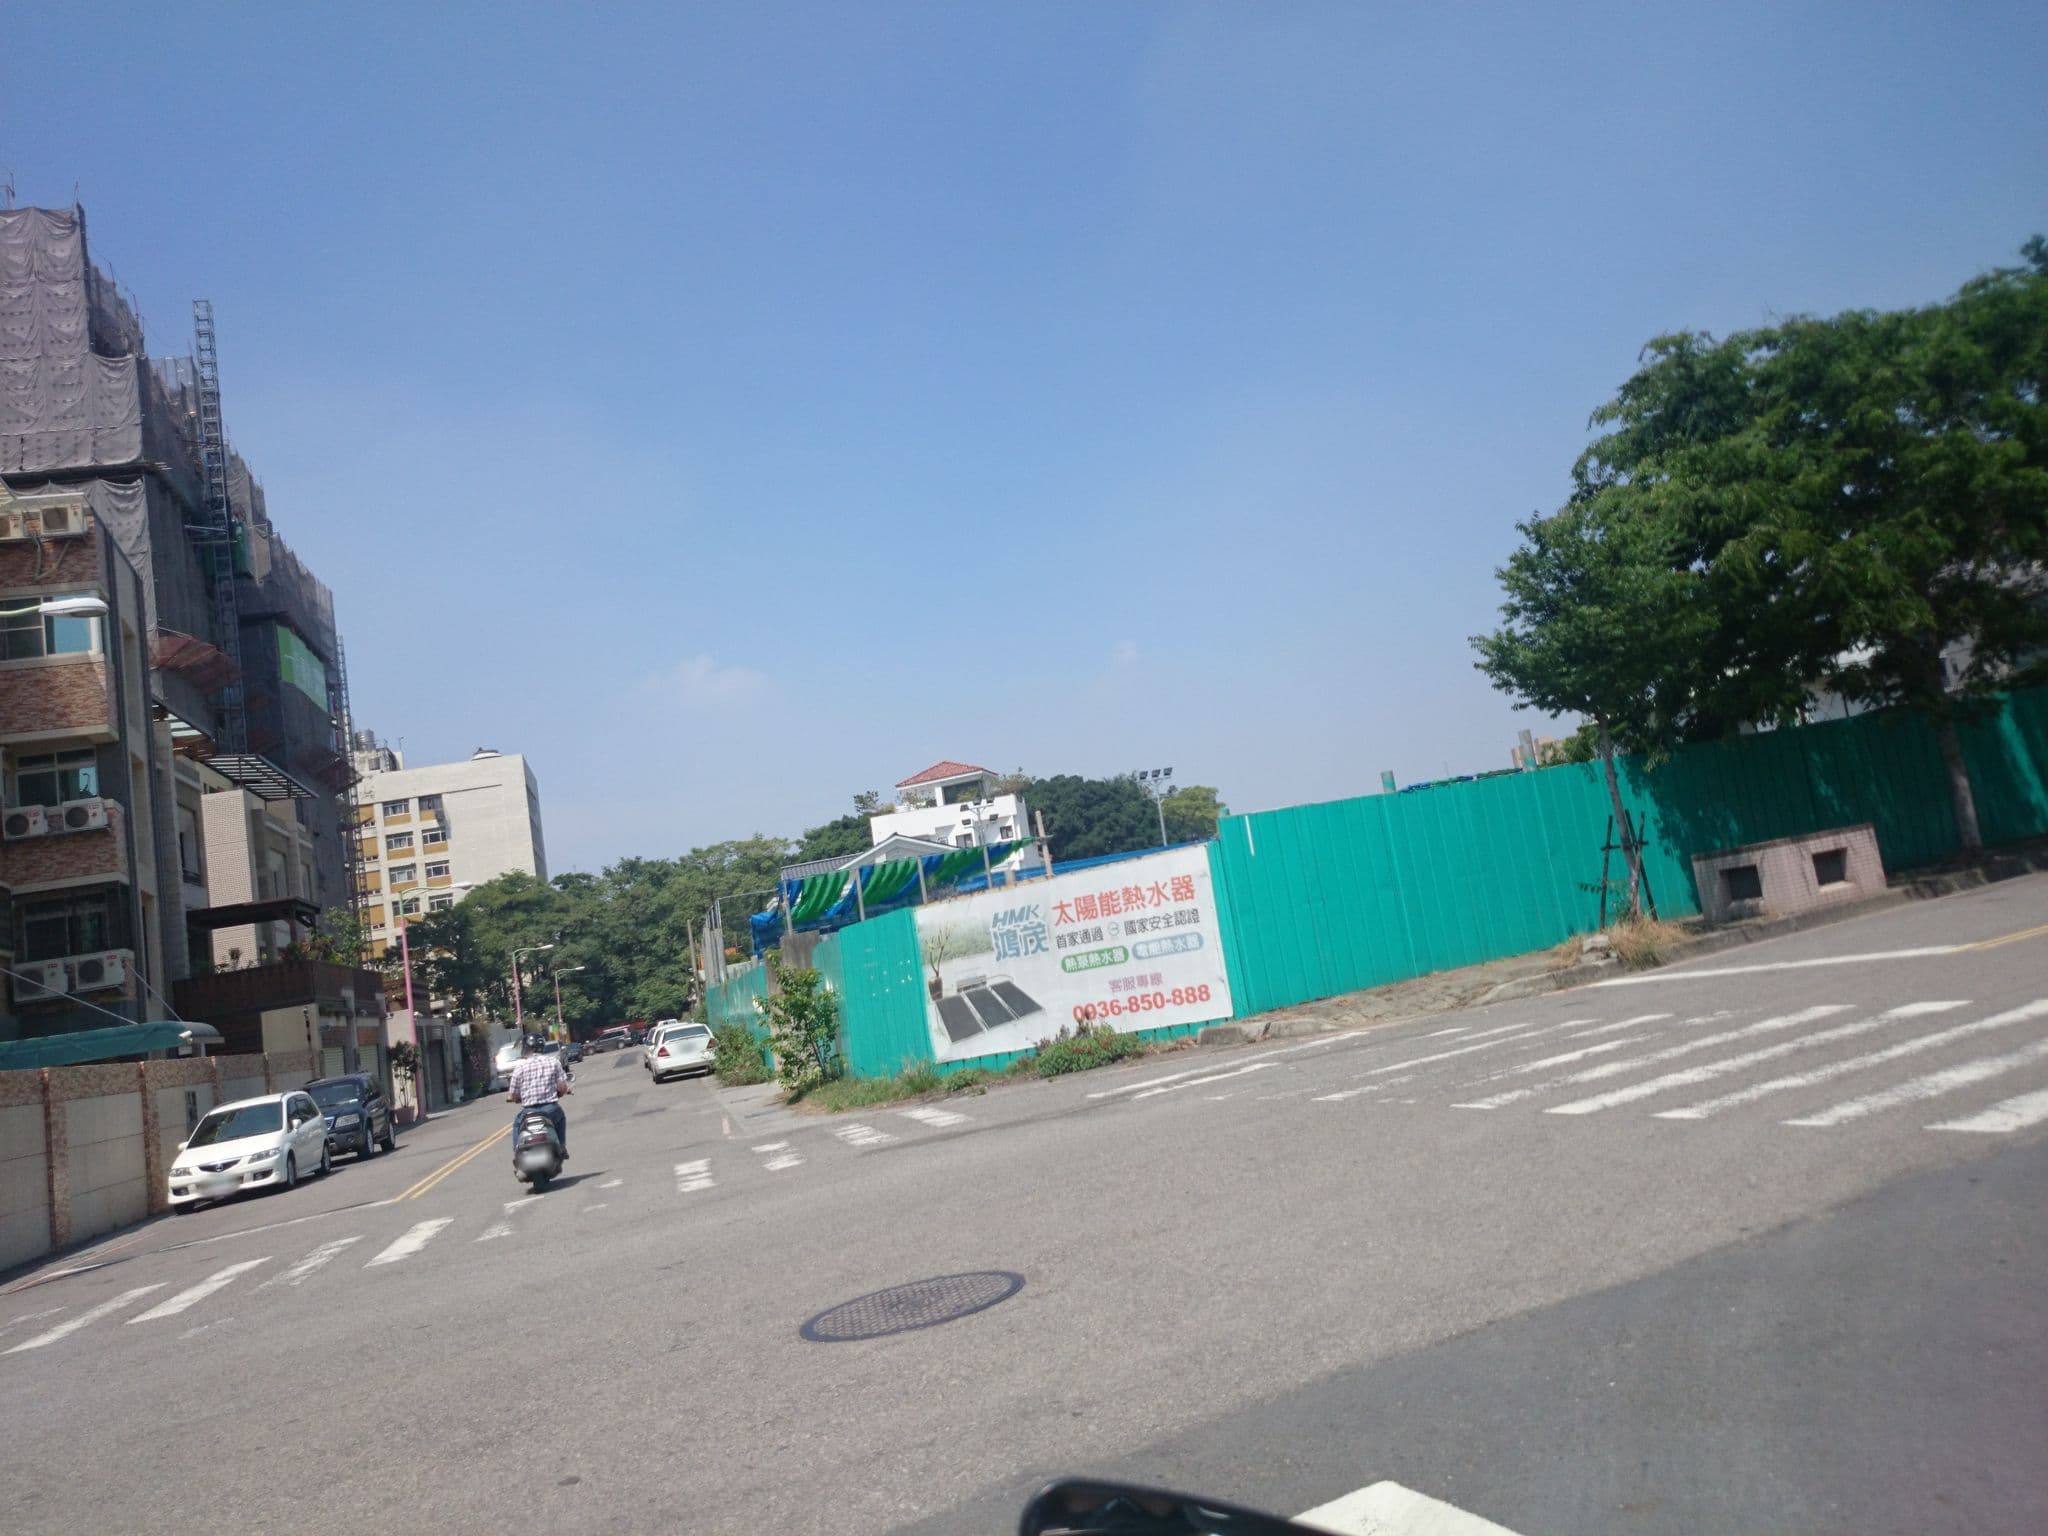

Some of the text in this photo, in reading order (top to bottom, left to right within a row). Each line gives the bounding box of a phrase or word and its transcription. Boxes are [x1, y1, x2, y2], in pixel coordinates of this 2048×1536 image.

[992, 904, 1040, 928] HMK
[1052, 875, 1195, 926] 太陽能熱水器
[992, 921, 1049, 961] 鴻茂
[1056, 908, 1200, 949] 首家通過 國家安全認證
[1073, 984, 1210, 1021] 0936-850-888
